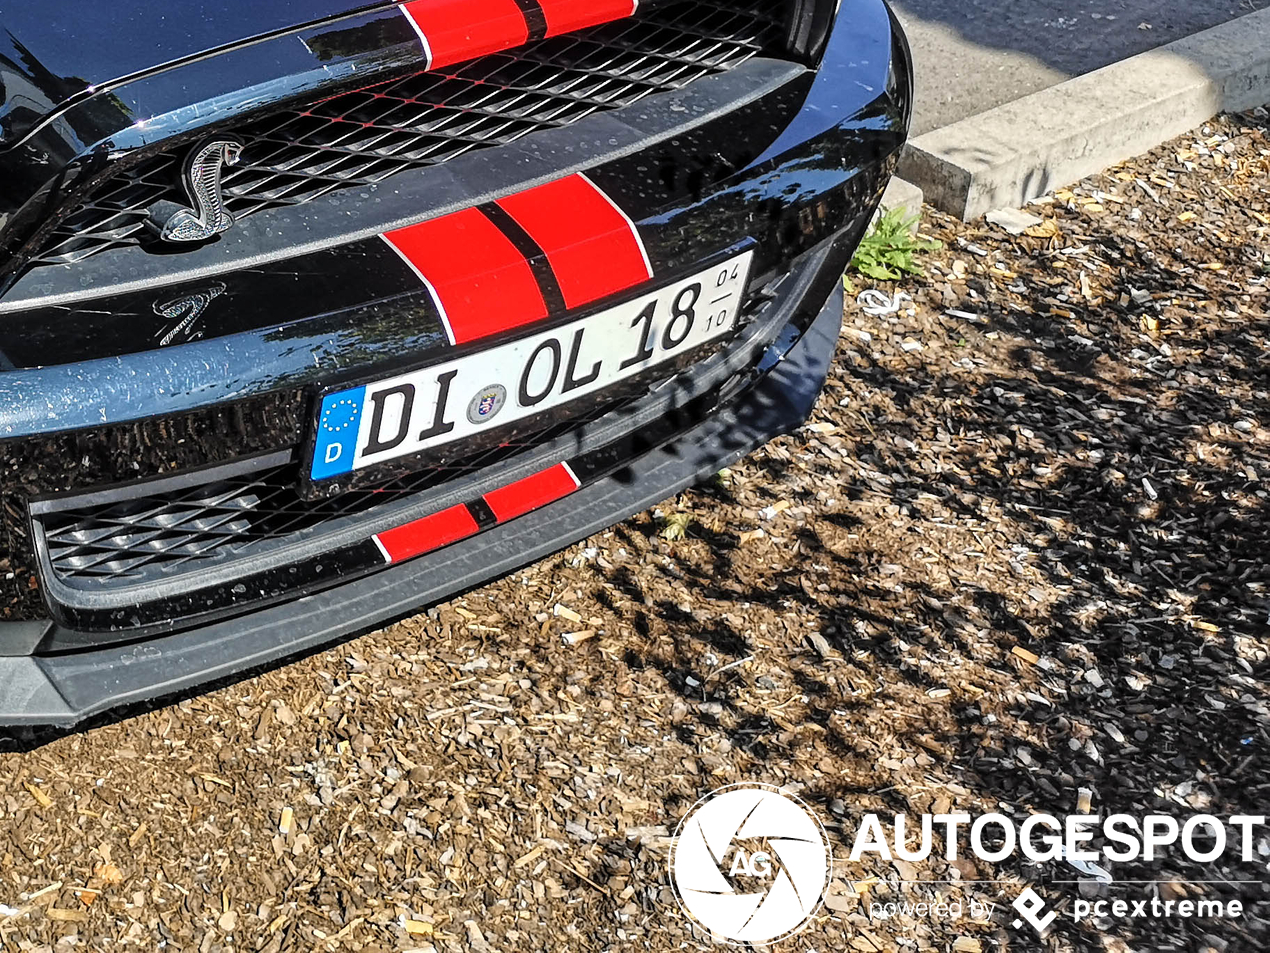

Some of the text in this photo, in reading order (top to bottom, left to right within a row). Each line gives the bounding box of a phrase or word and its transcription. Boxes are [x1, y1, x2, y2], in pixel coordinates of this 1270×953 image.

[716, 263, 739, 287] 04
[705, 309, 727, 332] 10
[361, 282, 701, 457] DI OL 18
[325, 443, 342, 463] D
